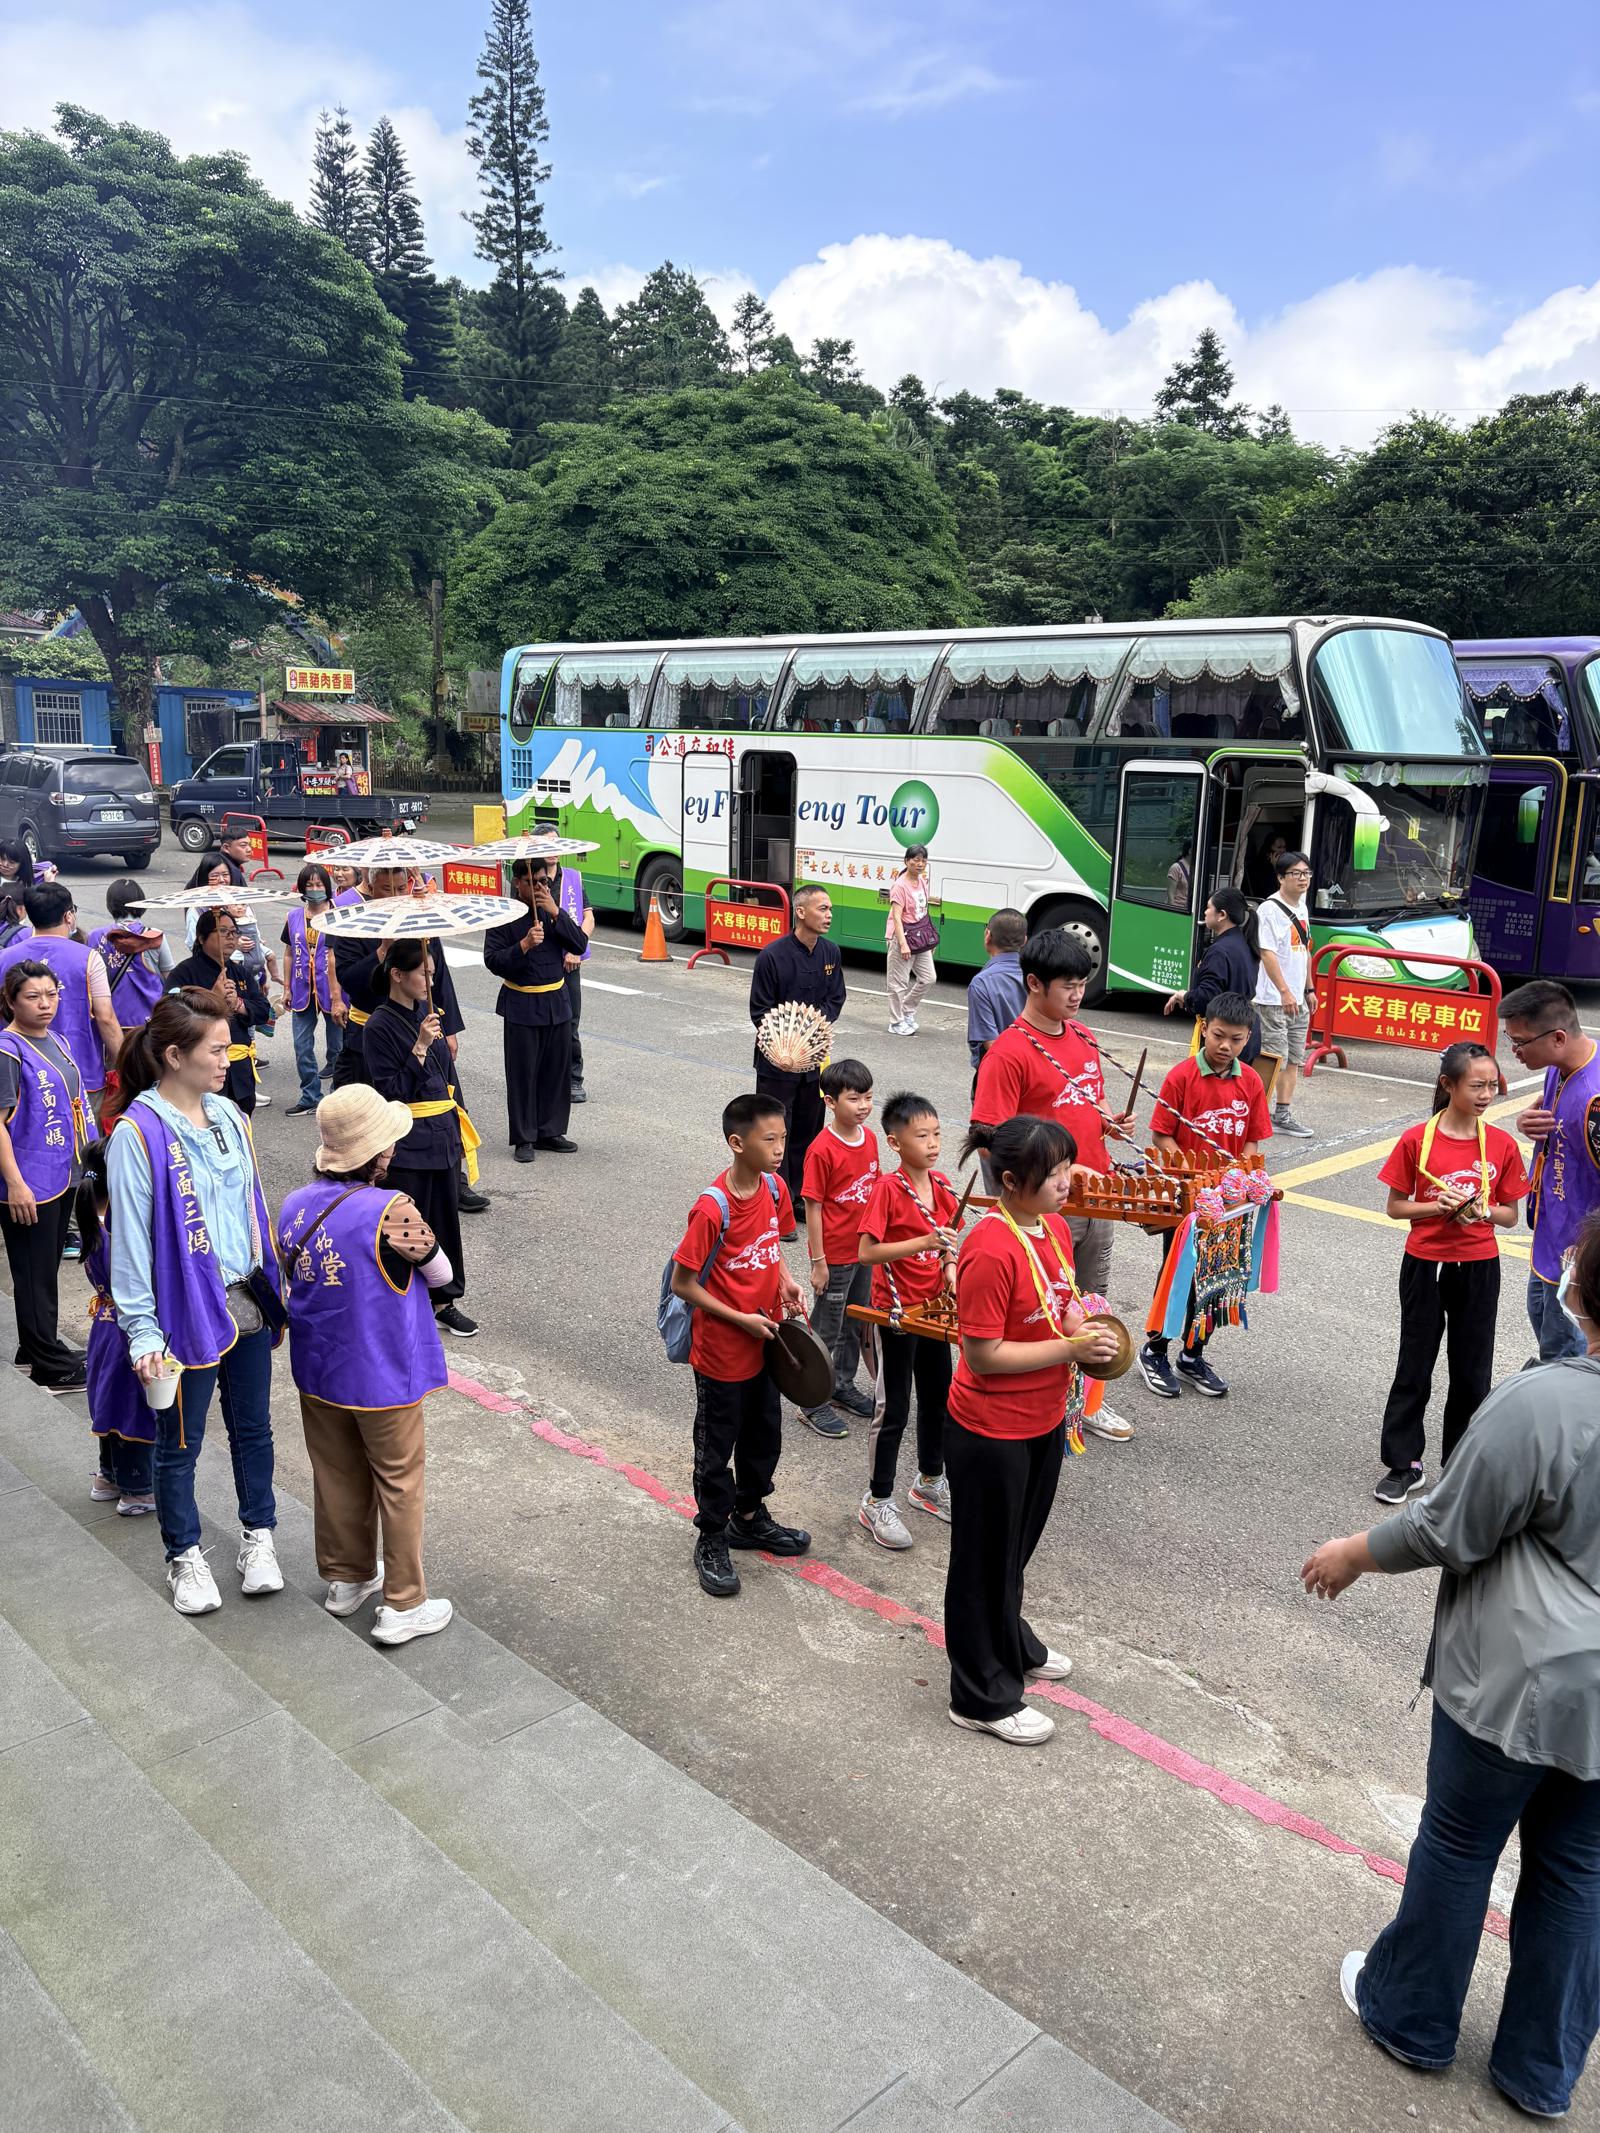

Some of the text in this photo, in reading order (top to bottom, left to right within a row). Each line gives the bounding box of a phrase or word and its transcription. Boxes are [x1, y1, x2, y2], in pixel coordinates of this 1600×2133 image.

[298, 671, 353, 690] 黑豬肉香腸
[856, 794, 926, 828] Tour
[448, 870, 496, 889] 大客車停車位
[712, 910, 781, 934] 大客車停車位
[1339, 992, 1482, 1032] 大客車停車位
[1374, 1024, 1440, 1043] 五指山玉皇宮
[37, 1069, 65, 1146] 黑面三媽
[1552, 1118, 1567, 1201] 天上聖母
[168, 1141, 210, 1255] 黑面三媽
[295, 1246, 346, 1286] 德堂
